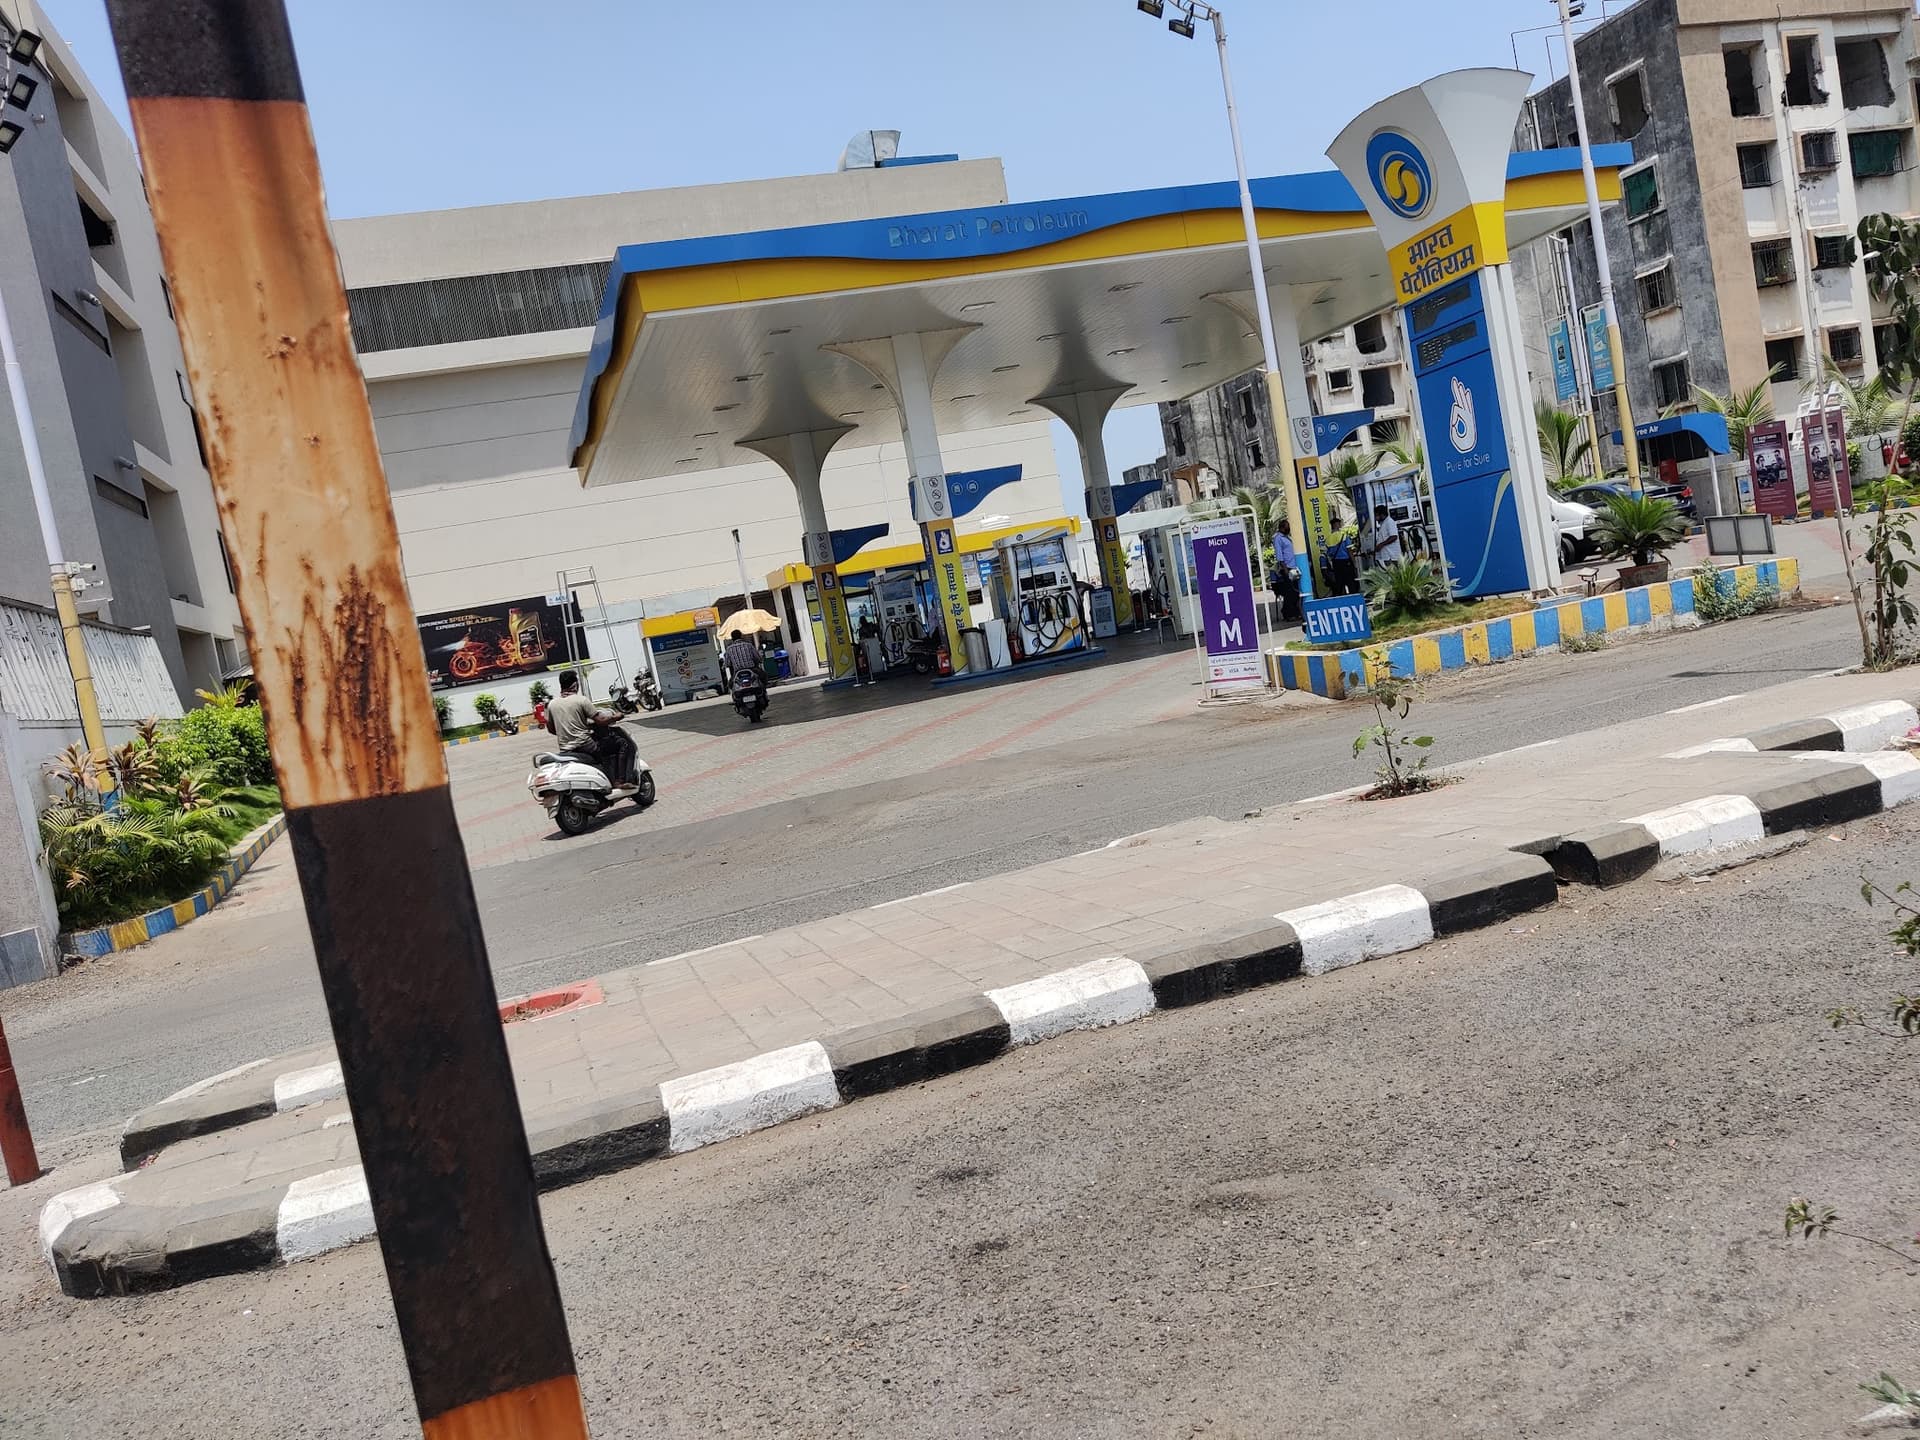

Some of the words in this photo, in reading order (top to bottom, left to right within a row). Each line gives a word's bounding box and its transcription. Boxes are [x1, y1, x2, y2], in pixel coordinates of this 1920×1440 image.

[887, 222, 968, 248] Bharat
[976, 210, 1088, 238] Petroleum
[1407, 224, 1454, 265] भारत
[1400, 244, 1476, 295] पेट्रोलियम
[1648, 425, 1659, 434] Air
[1445, 460, 1462, 472] Pure
[1463, 456, 1473, 468] for
[1473, 453, 1490, 466] Sure
[1208, 538, 1228, 548] Micro
[1306, 604, 1366, 638] ENTRY
